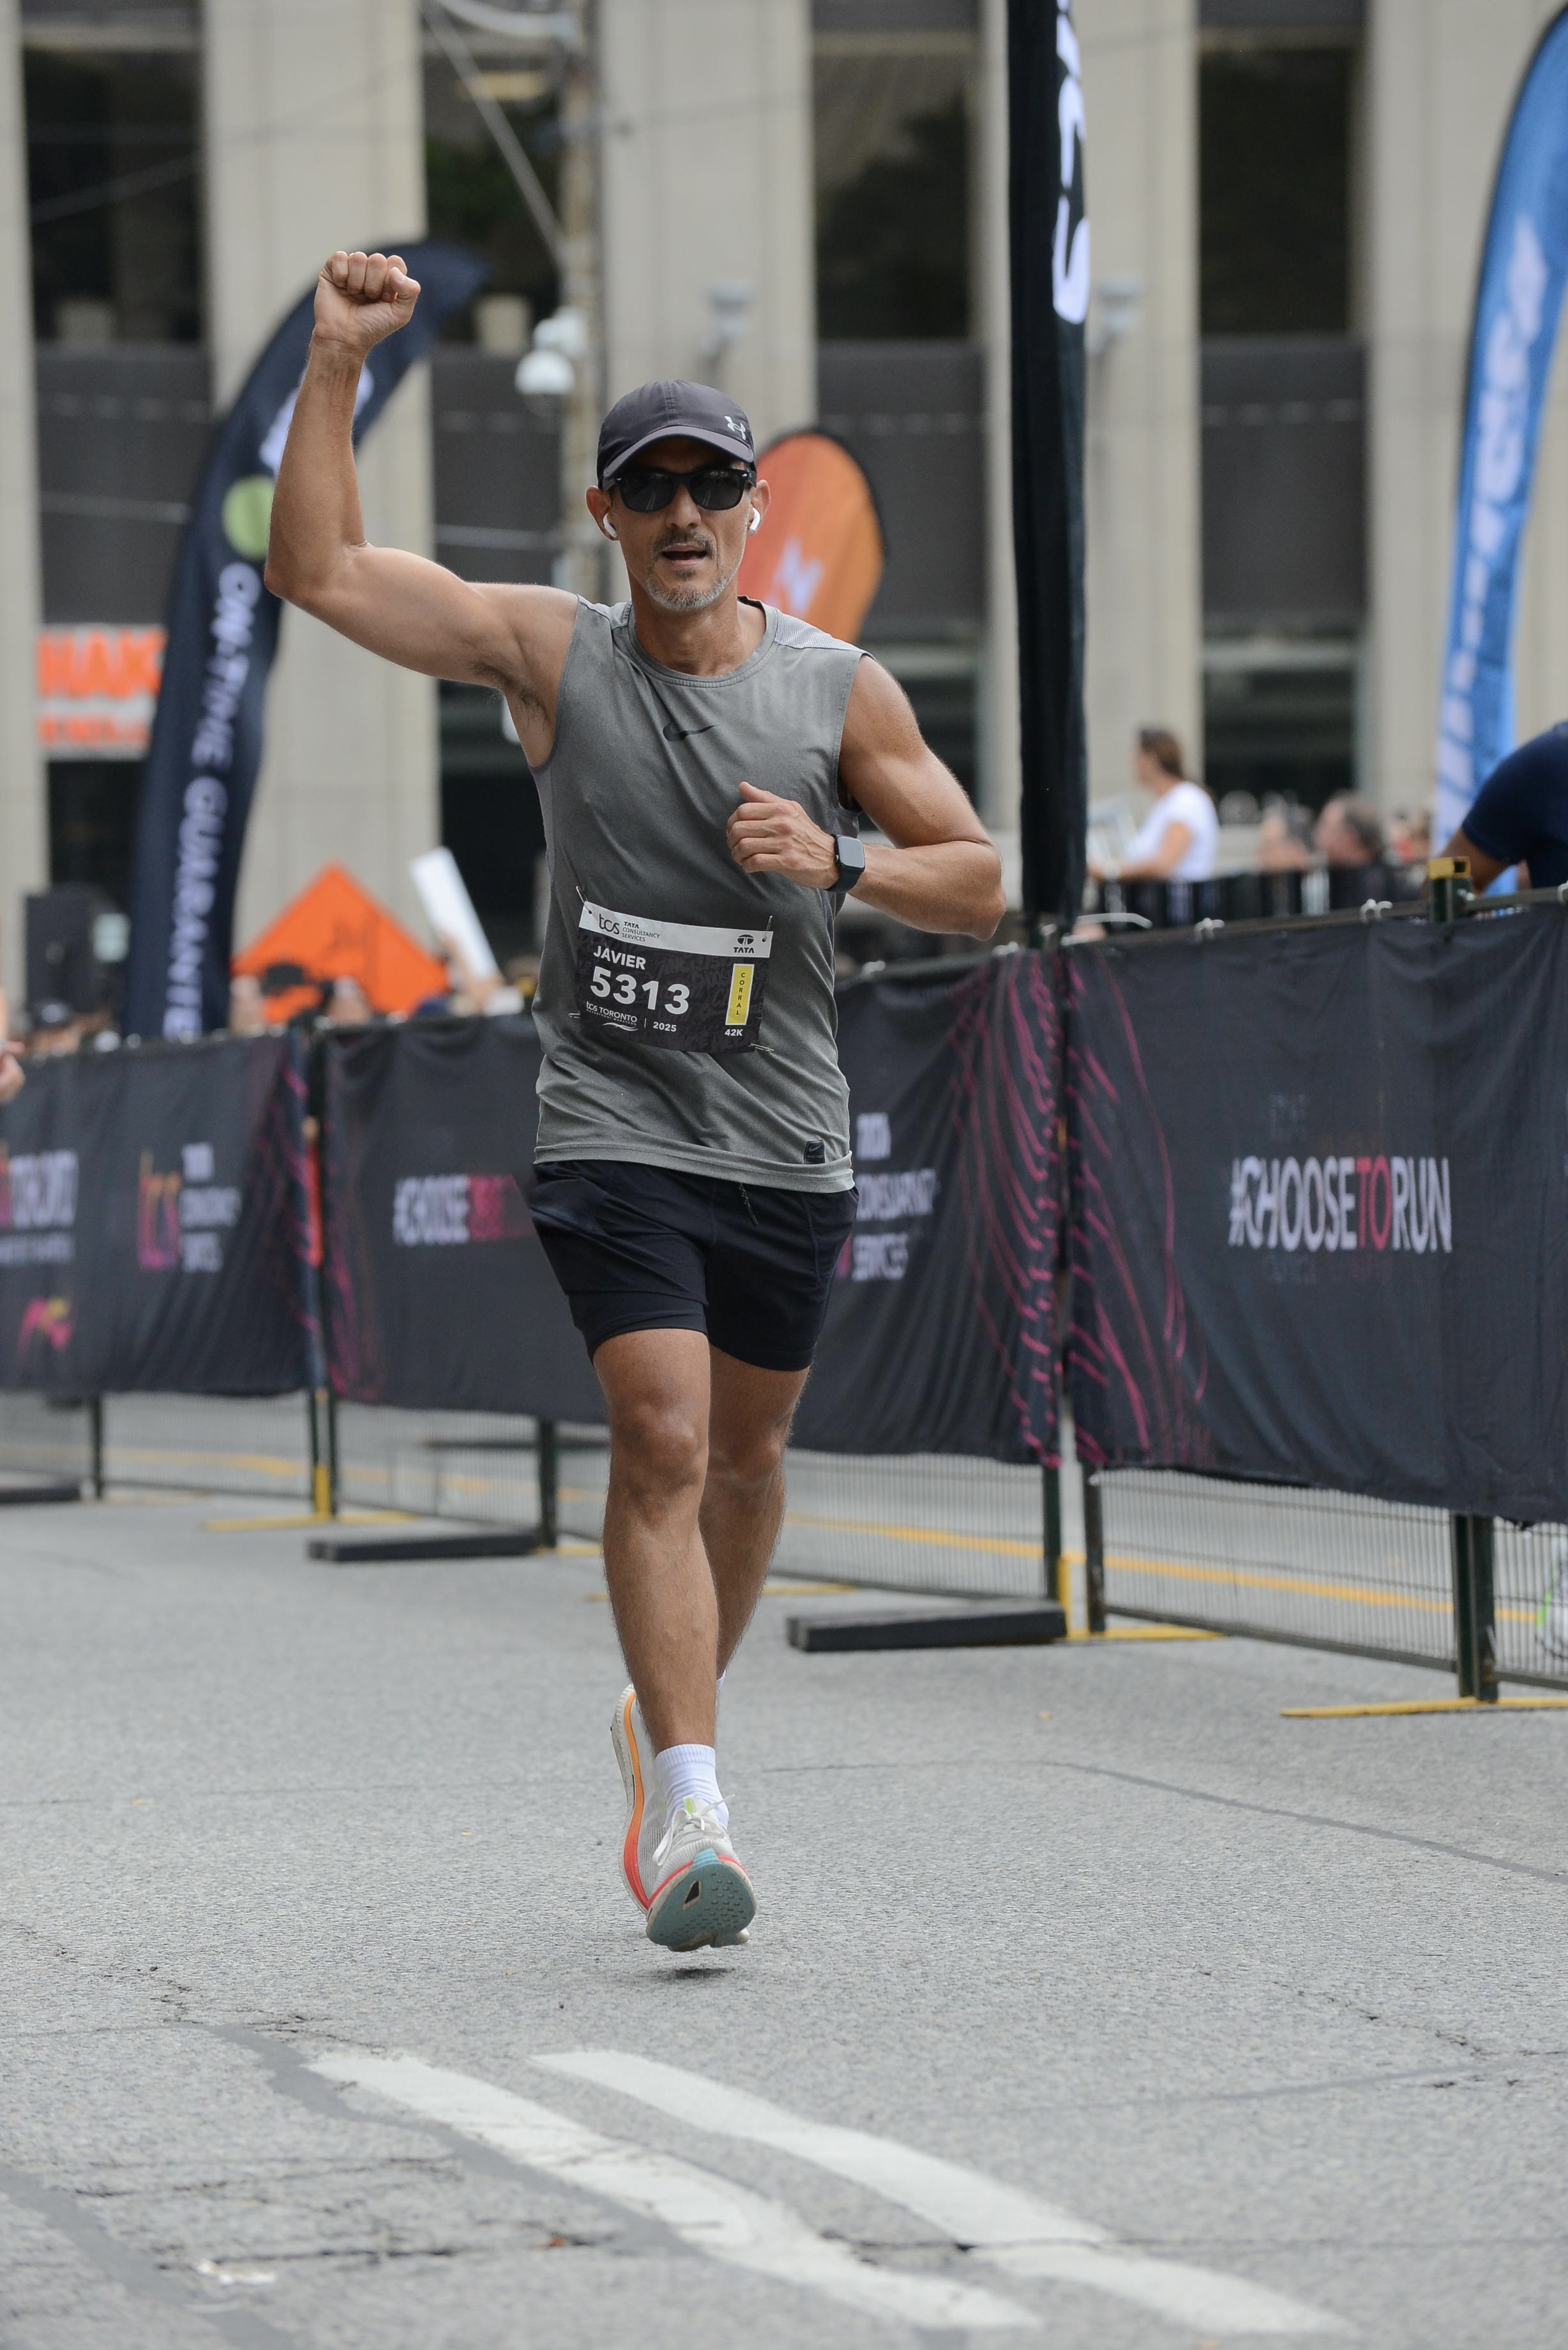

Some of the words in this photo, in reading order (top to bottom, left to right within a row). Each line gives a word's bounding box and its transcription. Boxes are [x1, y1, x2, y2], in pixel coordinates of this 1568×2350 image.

[599, 913, 620, 935] tcs
[623, 921, 640, 929] TATA
[621, 932, 646, 943] SERVICES
[622, 927, 661, 939] CONSULTANCY
[592, 945, 646, 970] JAVIER
[590, 966, 690, 1015] 5313
[735, 972, 746, 1015] CORRAL
[599, 1006, 638, 1023] TORONTO
[652, 1021, 677, 1032] 2025
[724, 1028, 744, 1036] 42K
[1228, 1154, 1453, 1255] #CHOOSETORUN
